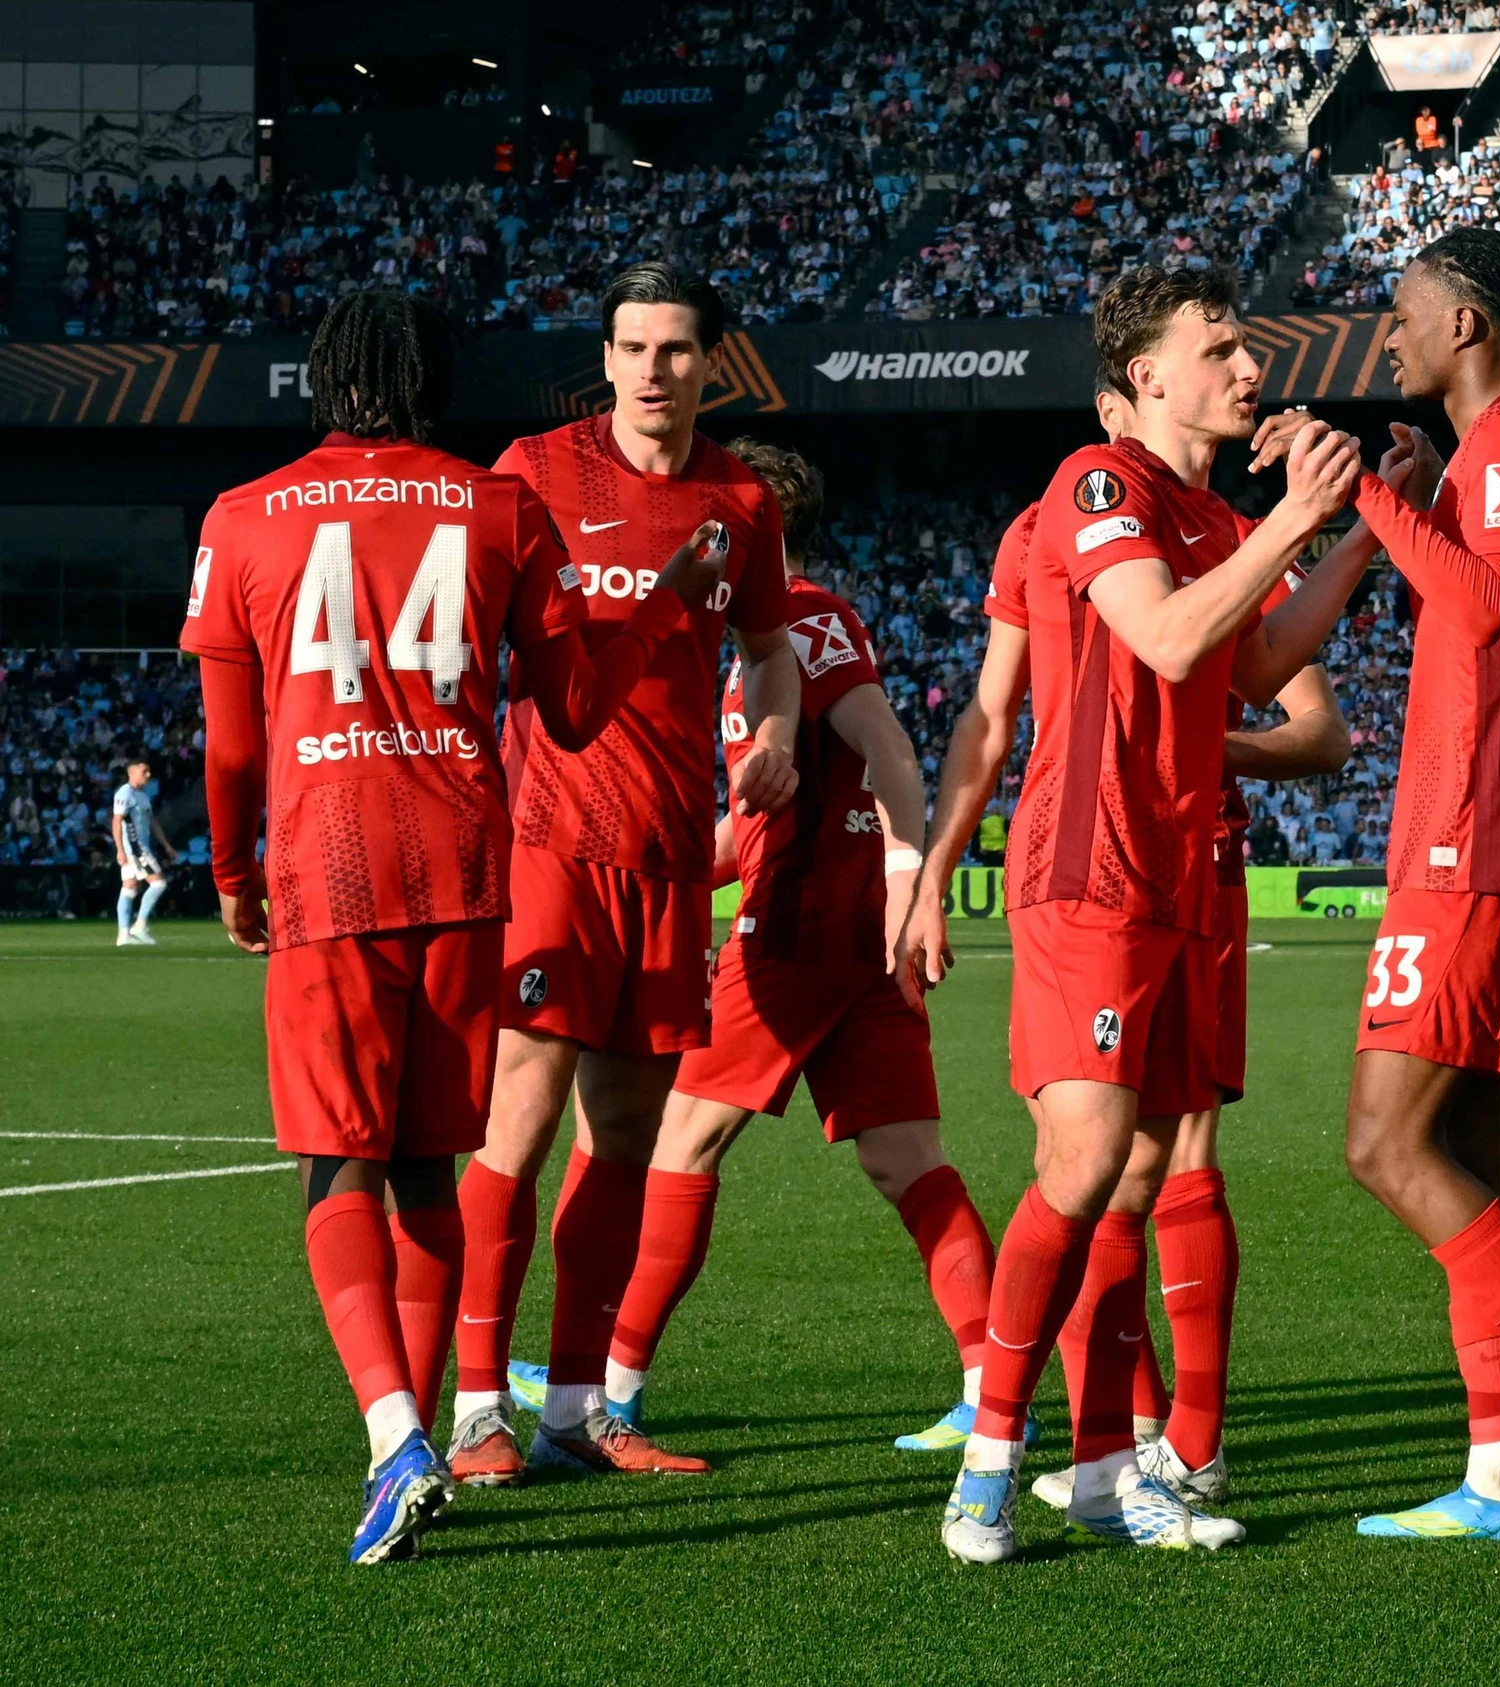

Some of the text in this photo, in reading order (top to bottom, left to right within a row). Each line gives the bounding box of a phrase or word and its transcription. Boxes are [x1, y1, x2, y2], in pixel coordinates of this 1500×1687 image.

[266, 475, 474, 516] manzambi
[580, 564, 732, 612] JOBD
[291, 521, 473, 705] 44
[295, 721, 479, 765] scfreiburg
[1366, 935, 1426, 1008] 33
